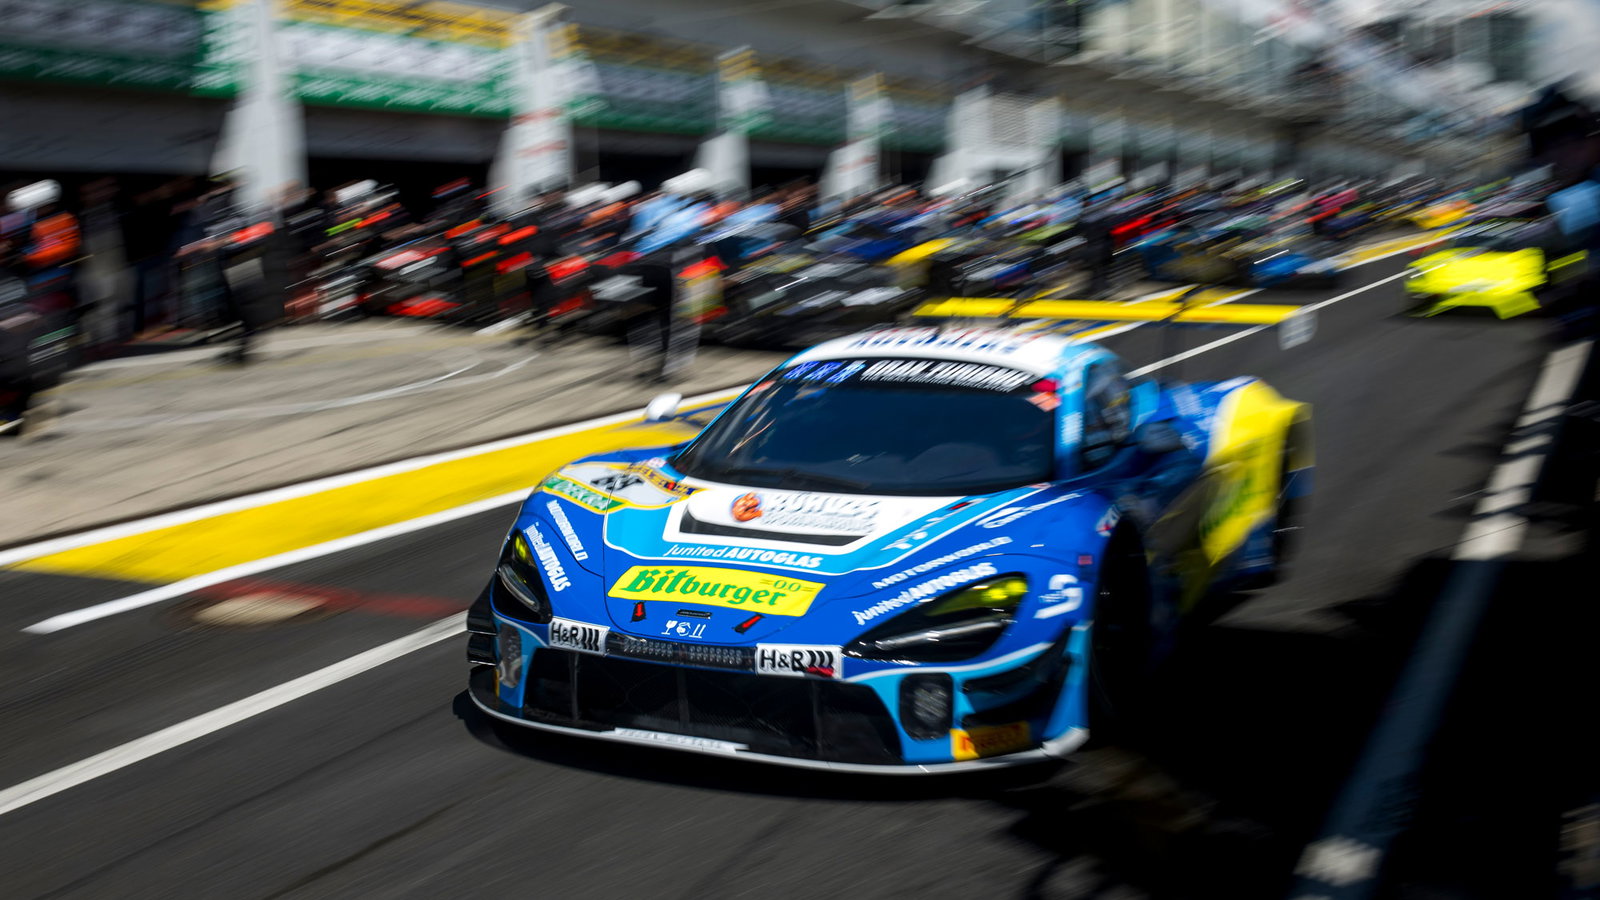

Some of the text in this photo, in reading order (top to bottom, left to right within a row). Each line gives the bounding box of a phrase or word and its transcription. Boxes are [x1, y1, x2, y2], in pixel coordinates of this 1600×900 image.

[619, 568, 787, 606] Bitburger
[551, 621, 580, 646] H&R
[760, 648, 807, 673] H&R
